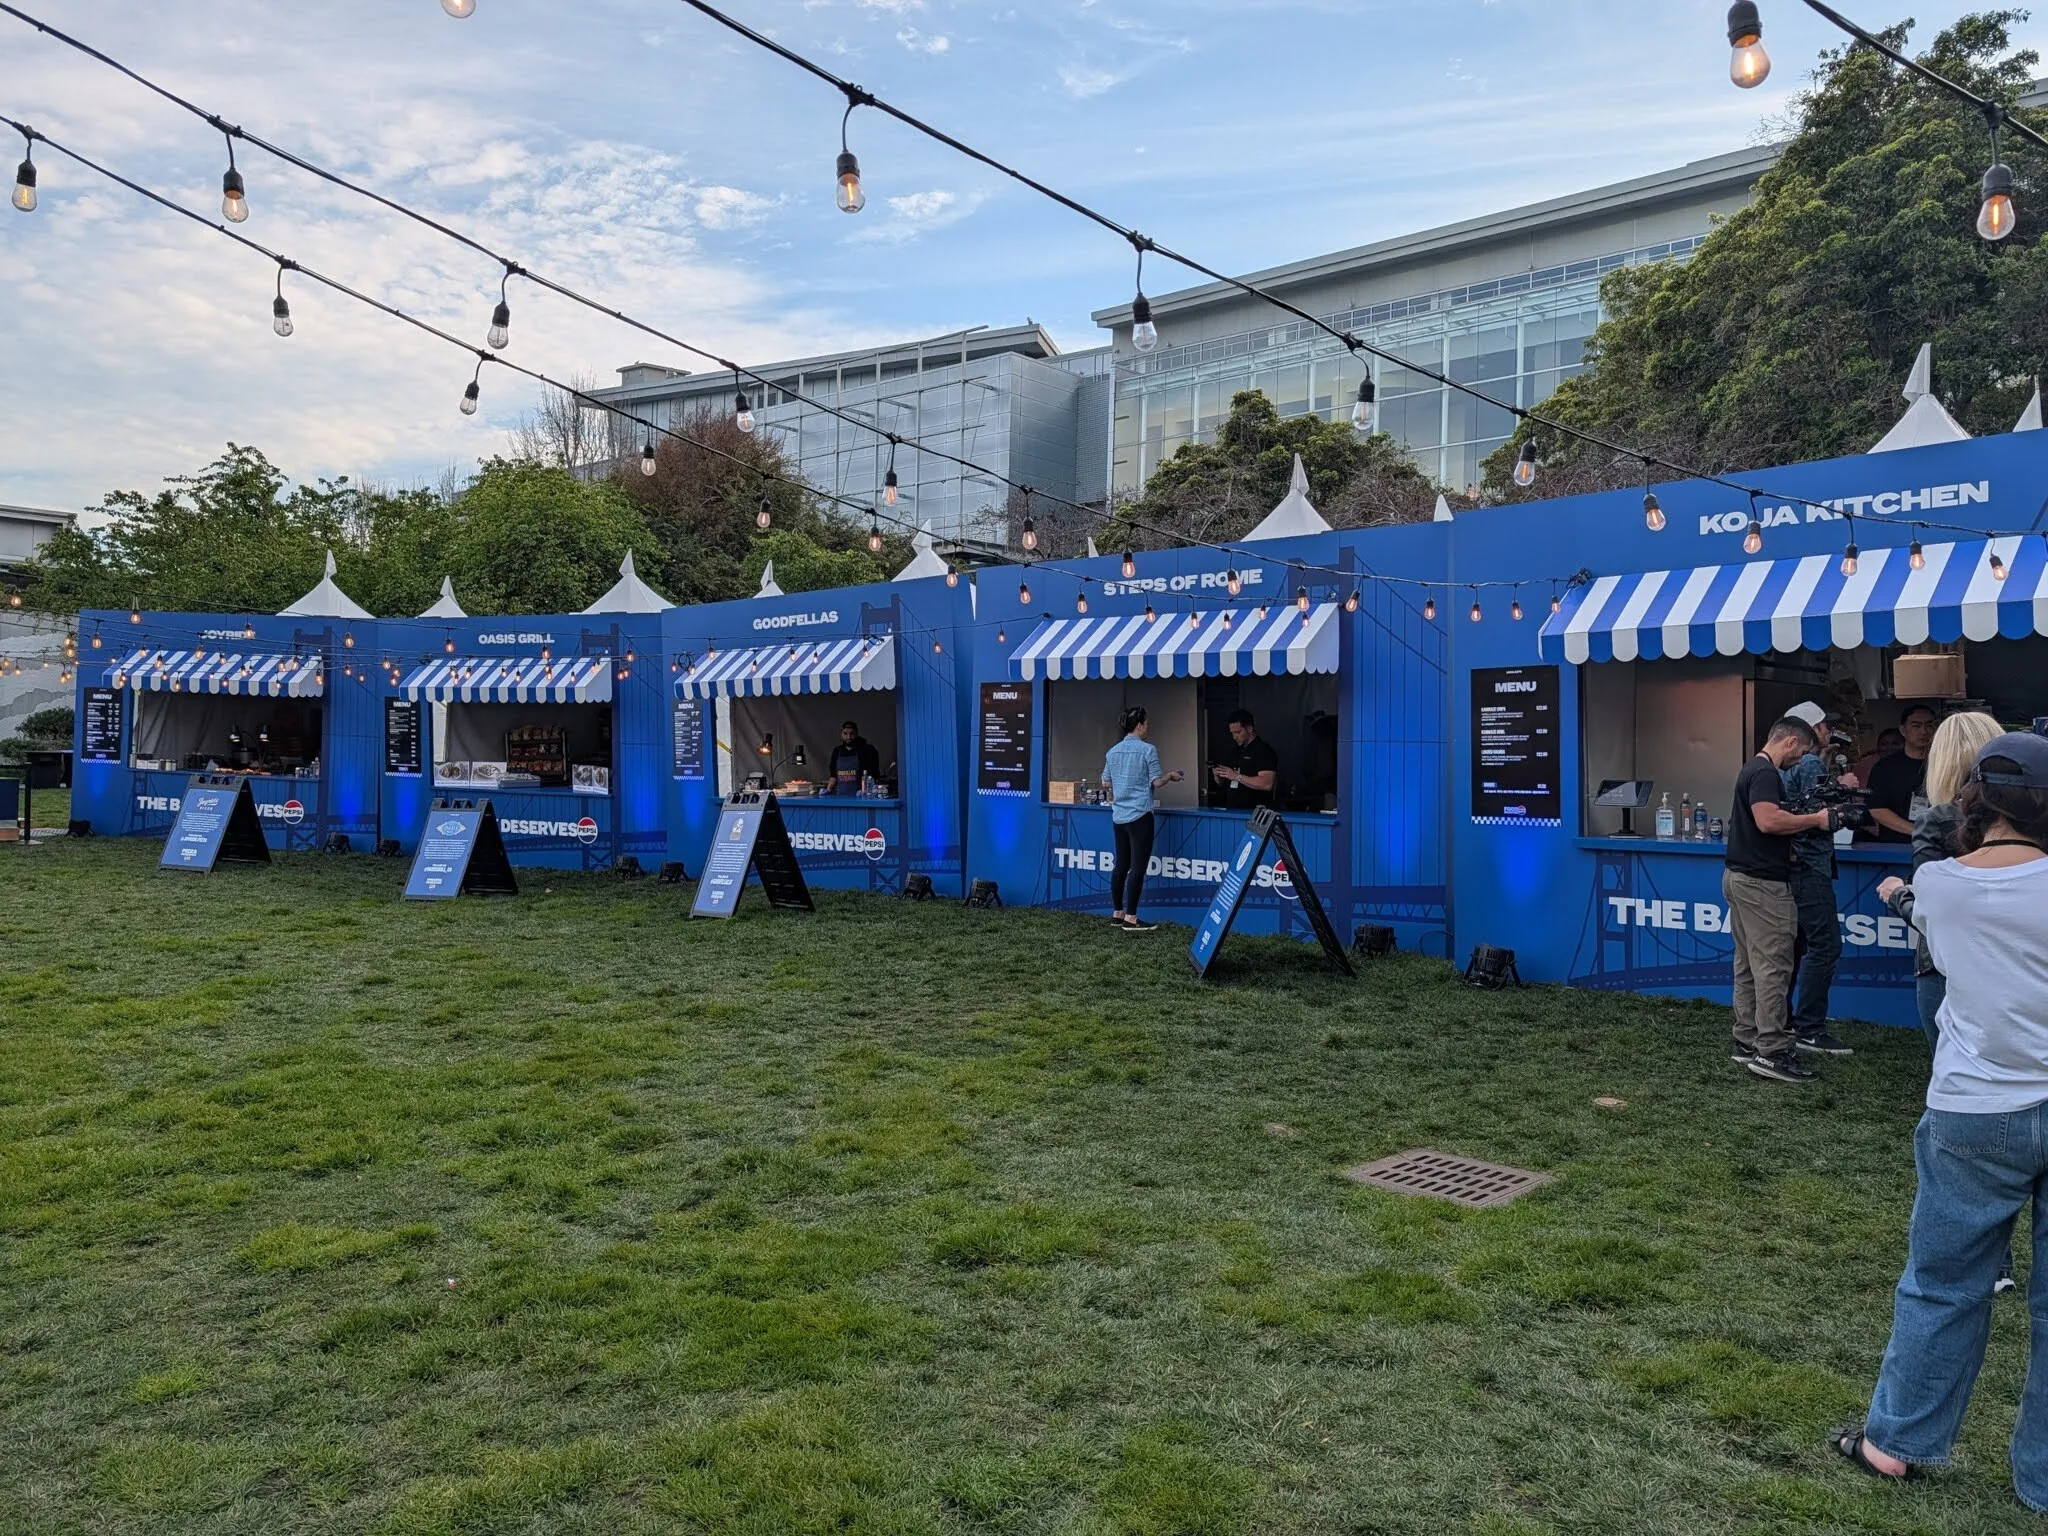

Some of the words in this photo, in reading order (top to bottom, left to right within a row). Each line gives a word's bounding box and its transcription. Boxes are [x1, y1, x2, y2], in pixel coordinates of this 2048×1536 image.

[1699, 505, 1800, 536] KOJA
[1806, 480, 1989, 523] KITCHEN
[1103, 577, 1167, 596] STEPS
[1170, 574, 1198, 591] OF
[752, 610, 839, 630] GOODFELLAS
[478, 633, 516, 644] OASIS
[993, 692, 1018, 700] MENU
[1495, 681, 1537, 693] MENU
[137, 795, 167, 811] THE
[500, 818, 578, 837] DESERVES
[786, 832, 865, 852] DESERVES
[1054, 847, 1096, 870] THE
[1609, 896, 1687, 930] THE
